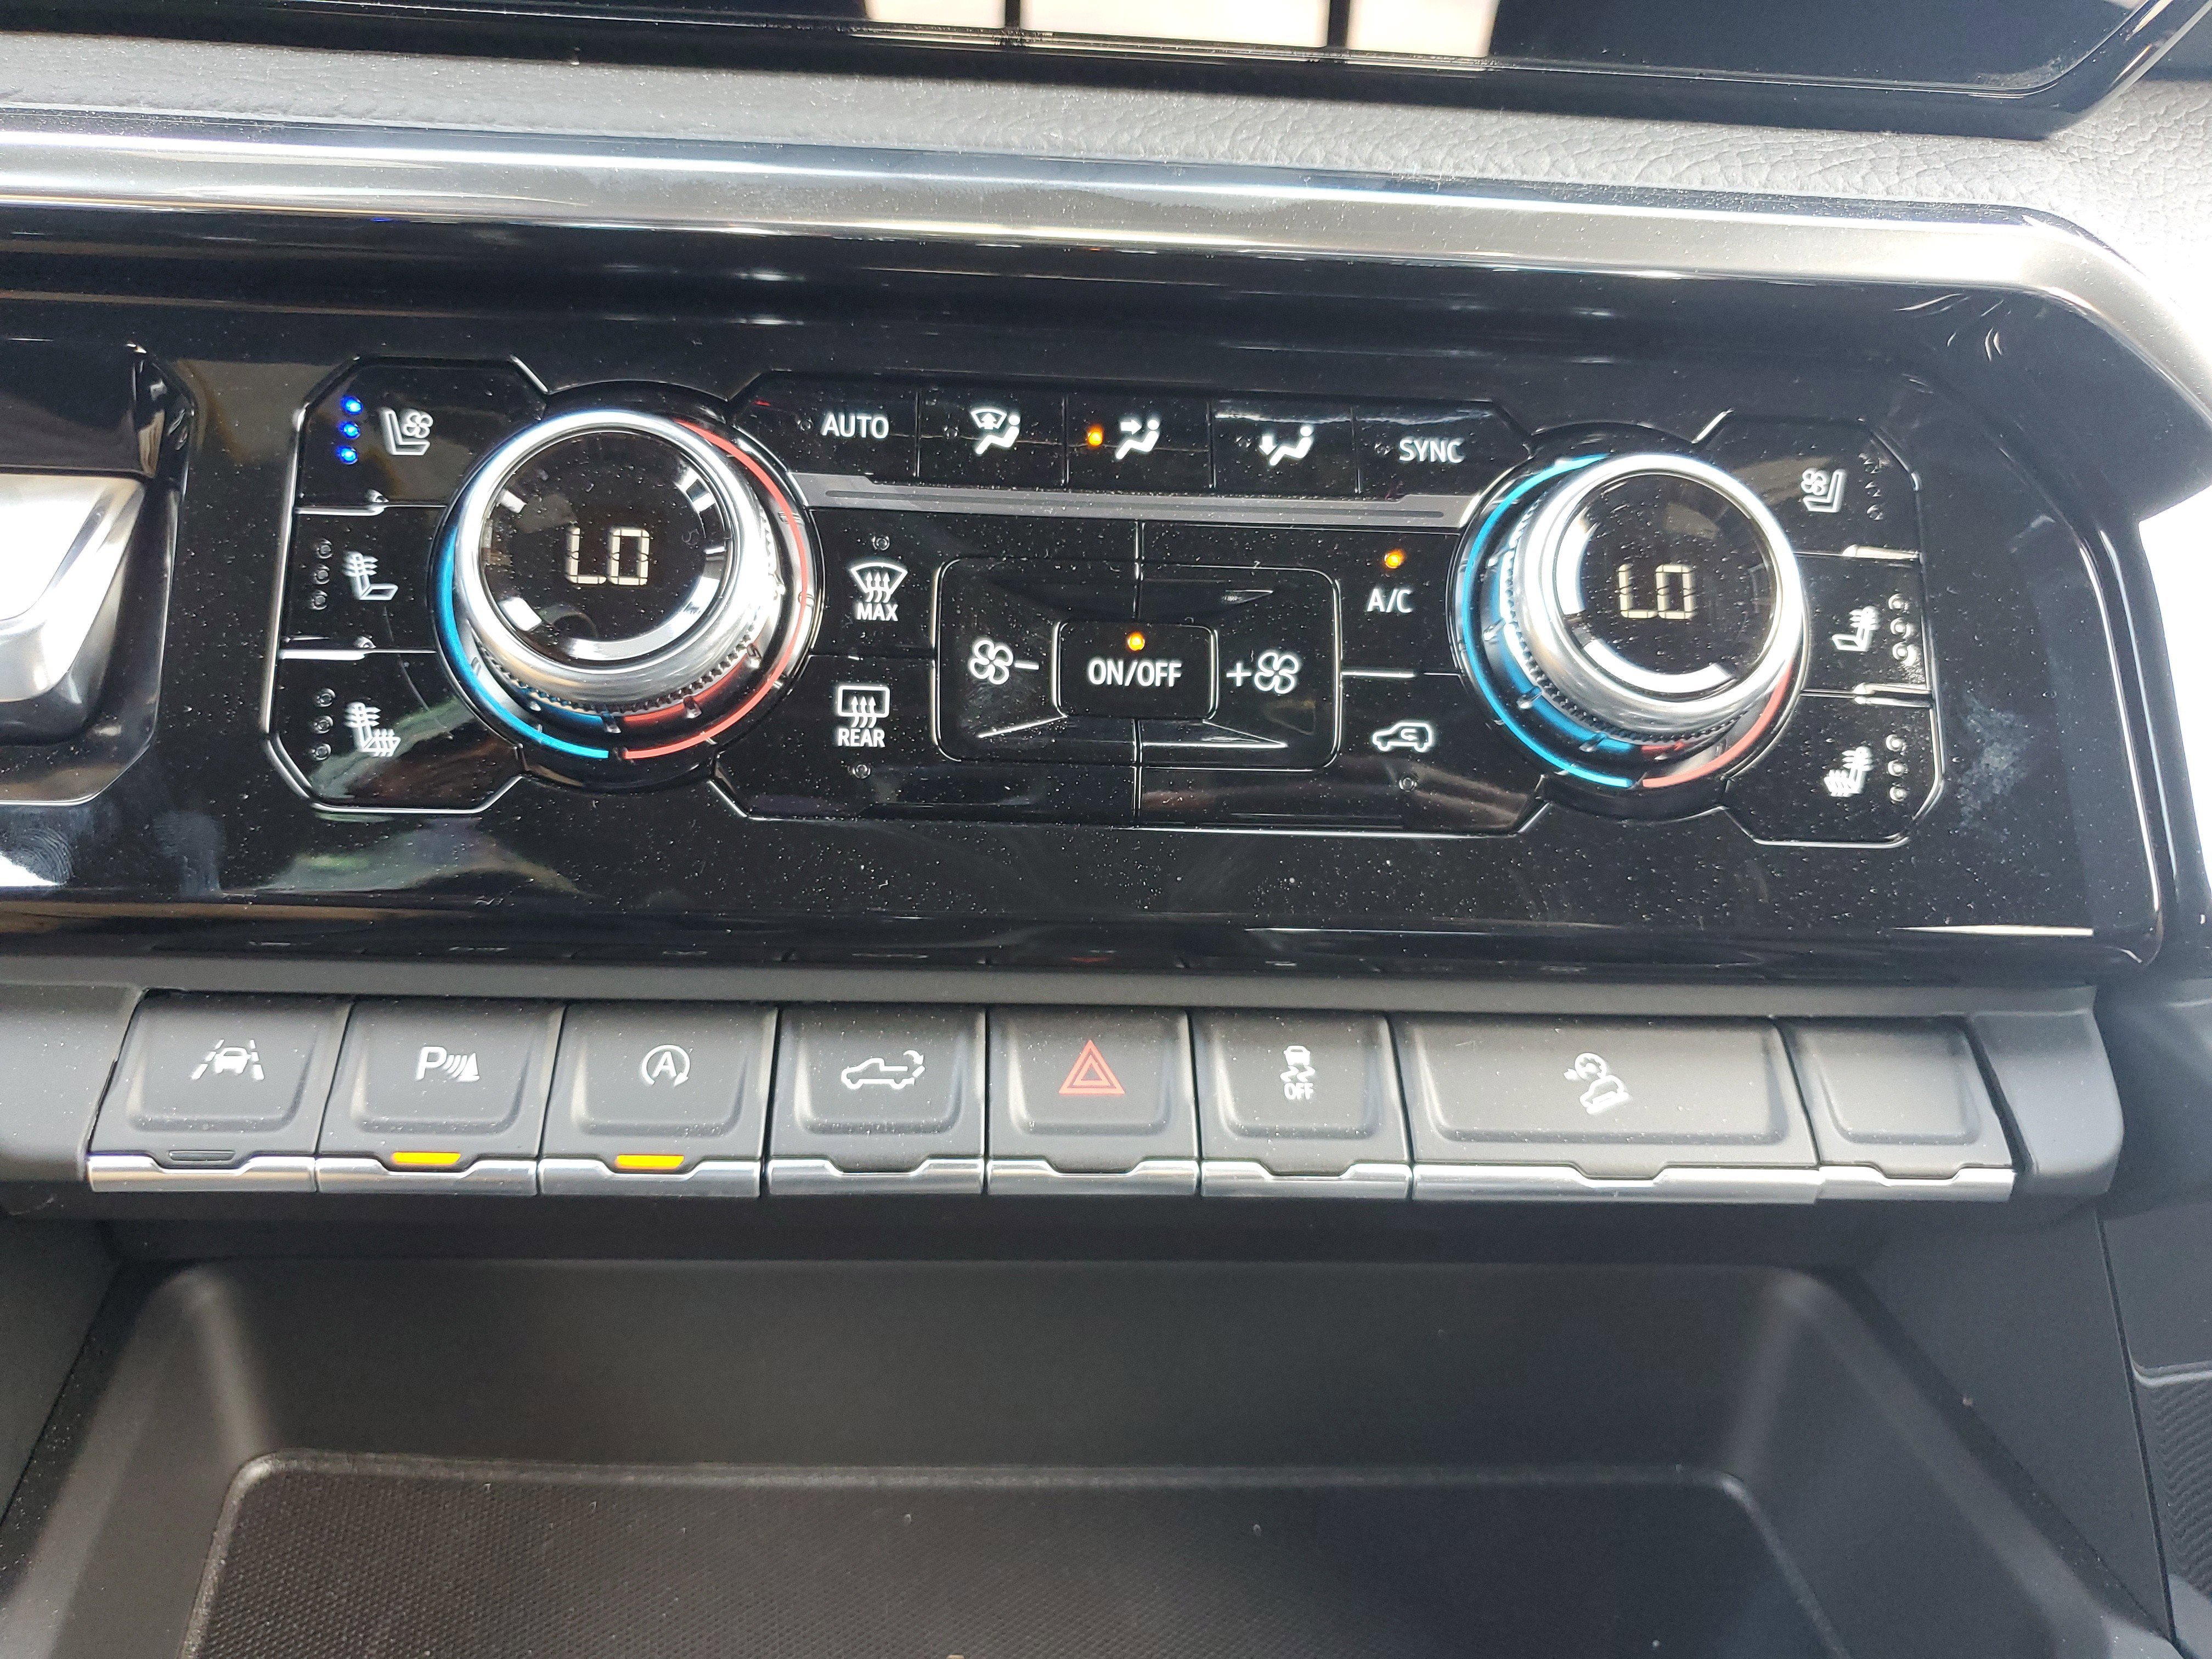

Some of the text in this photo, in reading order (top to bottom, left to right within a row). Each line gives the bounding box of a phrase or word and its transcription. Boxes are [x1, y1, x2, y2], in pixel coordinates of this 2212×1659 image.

[822, 415, 889, 438] AUTO
[1400, 439, 1465, 464] SYNC
[856, 603, 899, 622] MAX
[1368, 589, 1413, 613] A/C
[1088, 661, 1182, 686] ON/OFF
[837, 727, 885, 747] REAR
[415, 1046, 447, 1080] P
[1284, 1082, 1314, 1100] OFF
